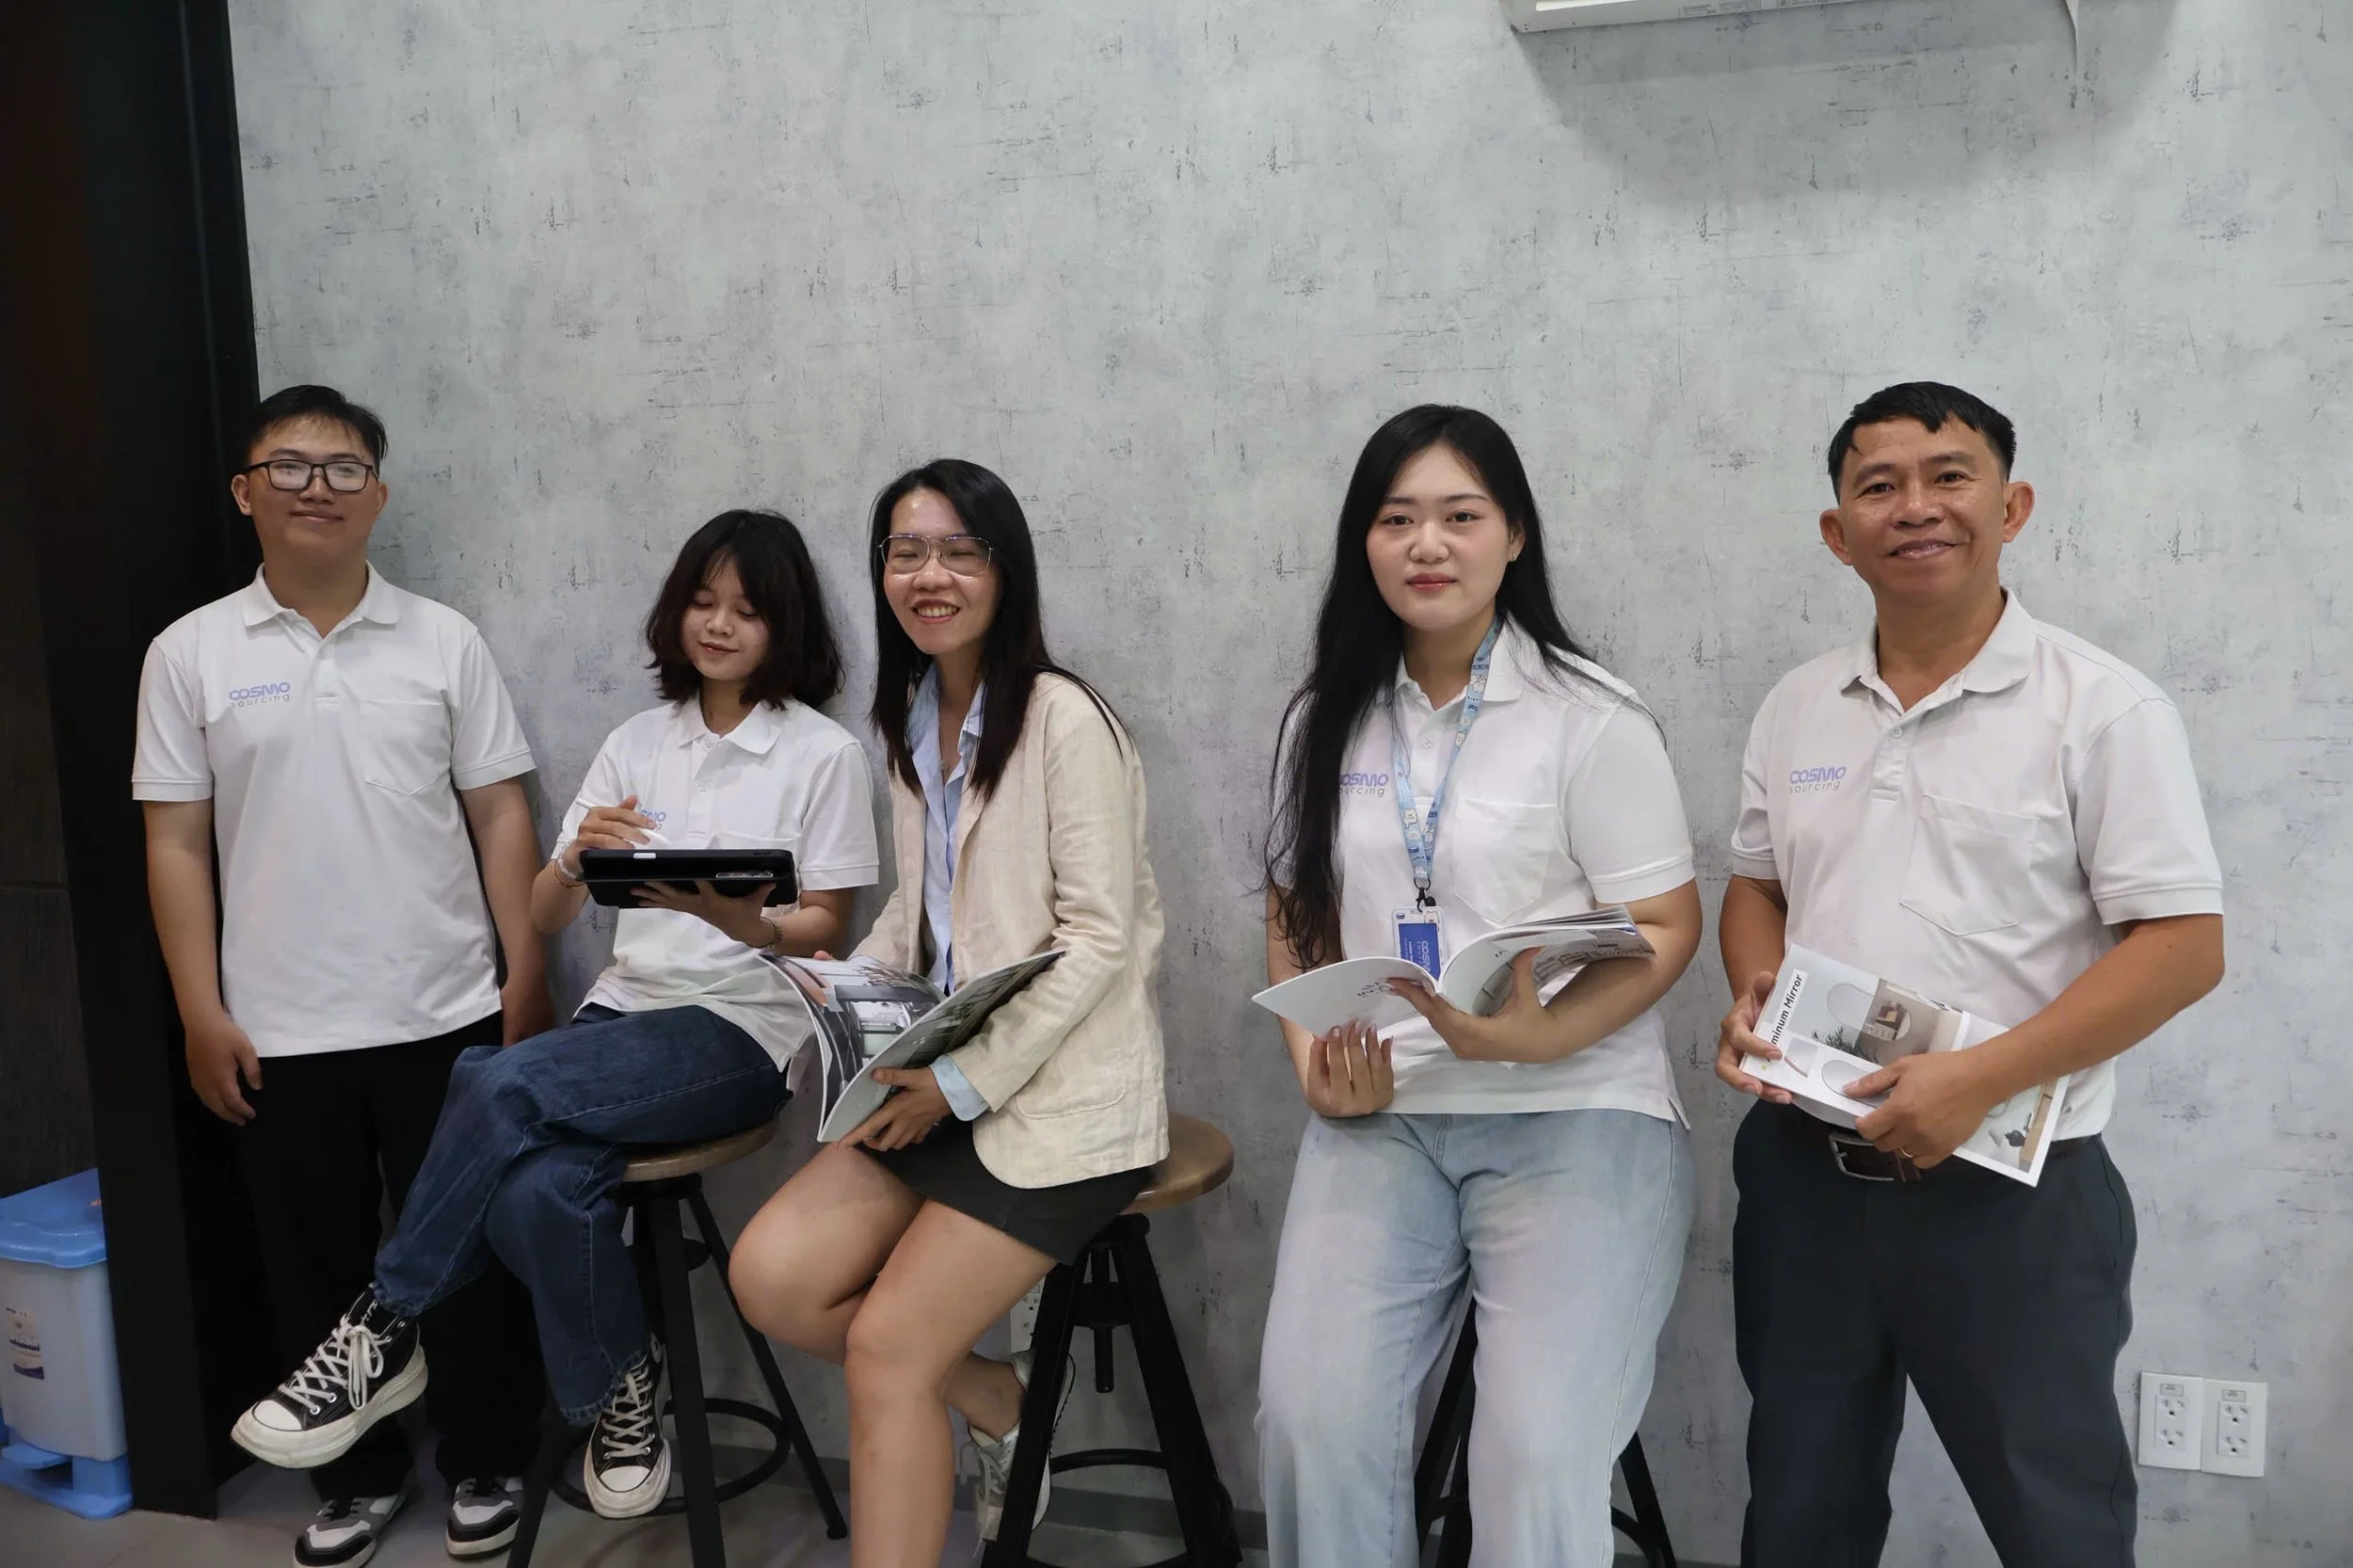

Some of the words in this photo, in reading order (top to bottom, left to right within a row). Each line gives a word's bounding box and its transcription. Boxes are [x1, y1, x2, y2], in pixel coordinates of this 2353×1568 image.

[230, 682, 290, 700] COSMO
[231, 694, 289, 708] sourcing
[1338, 772, 1388, 787] OSMO
[1791, 767, 1847, 784] COSMO
[1340, 787, 1385, 797] ourcing
[1788, 781, 1841, 793] sourcing
[1421, 940, 1431, 972] COSM
[1770, 1011, 1788, 1046] minum
[1784, 974, 1802, 1008] Mirror
